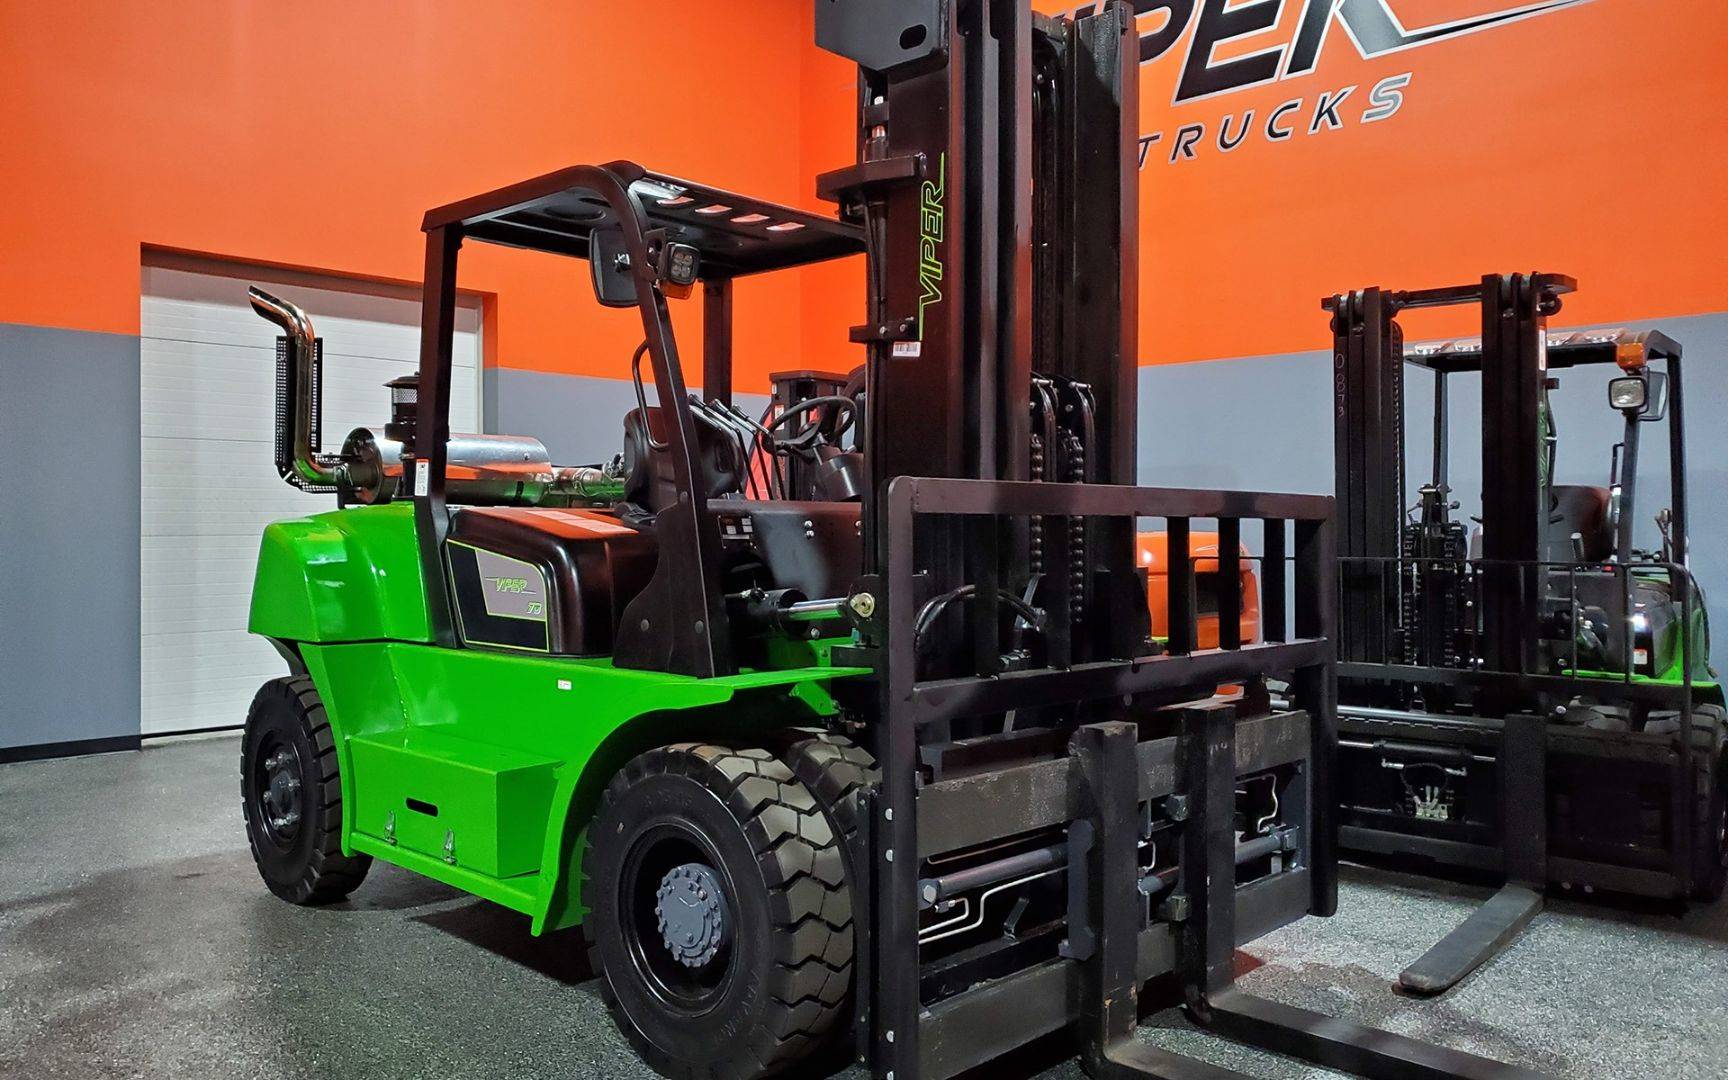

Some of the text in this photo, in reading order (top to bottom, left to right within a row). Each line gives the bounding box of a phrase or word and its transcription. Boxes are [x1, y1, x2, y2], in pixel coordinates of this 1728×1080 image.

[1138, 72, 1412, 170] TRUCKS
[919, 179, 944, 307] VIPER
[492, 576, 530, 594] VIPER
